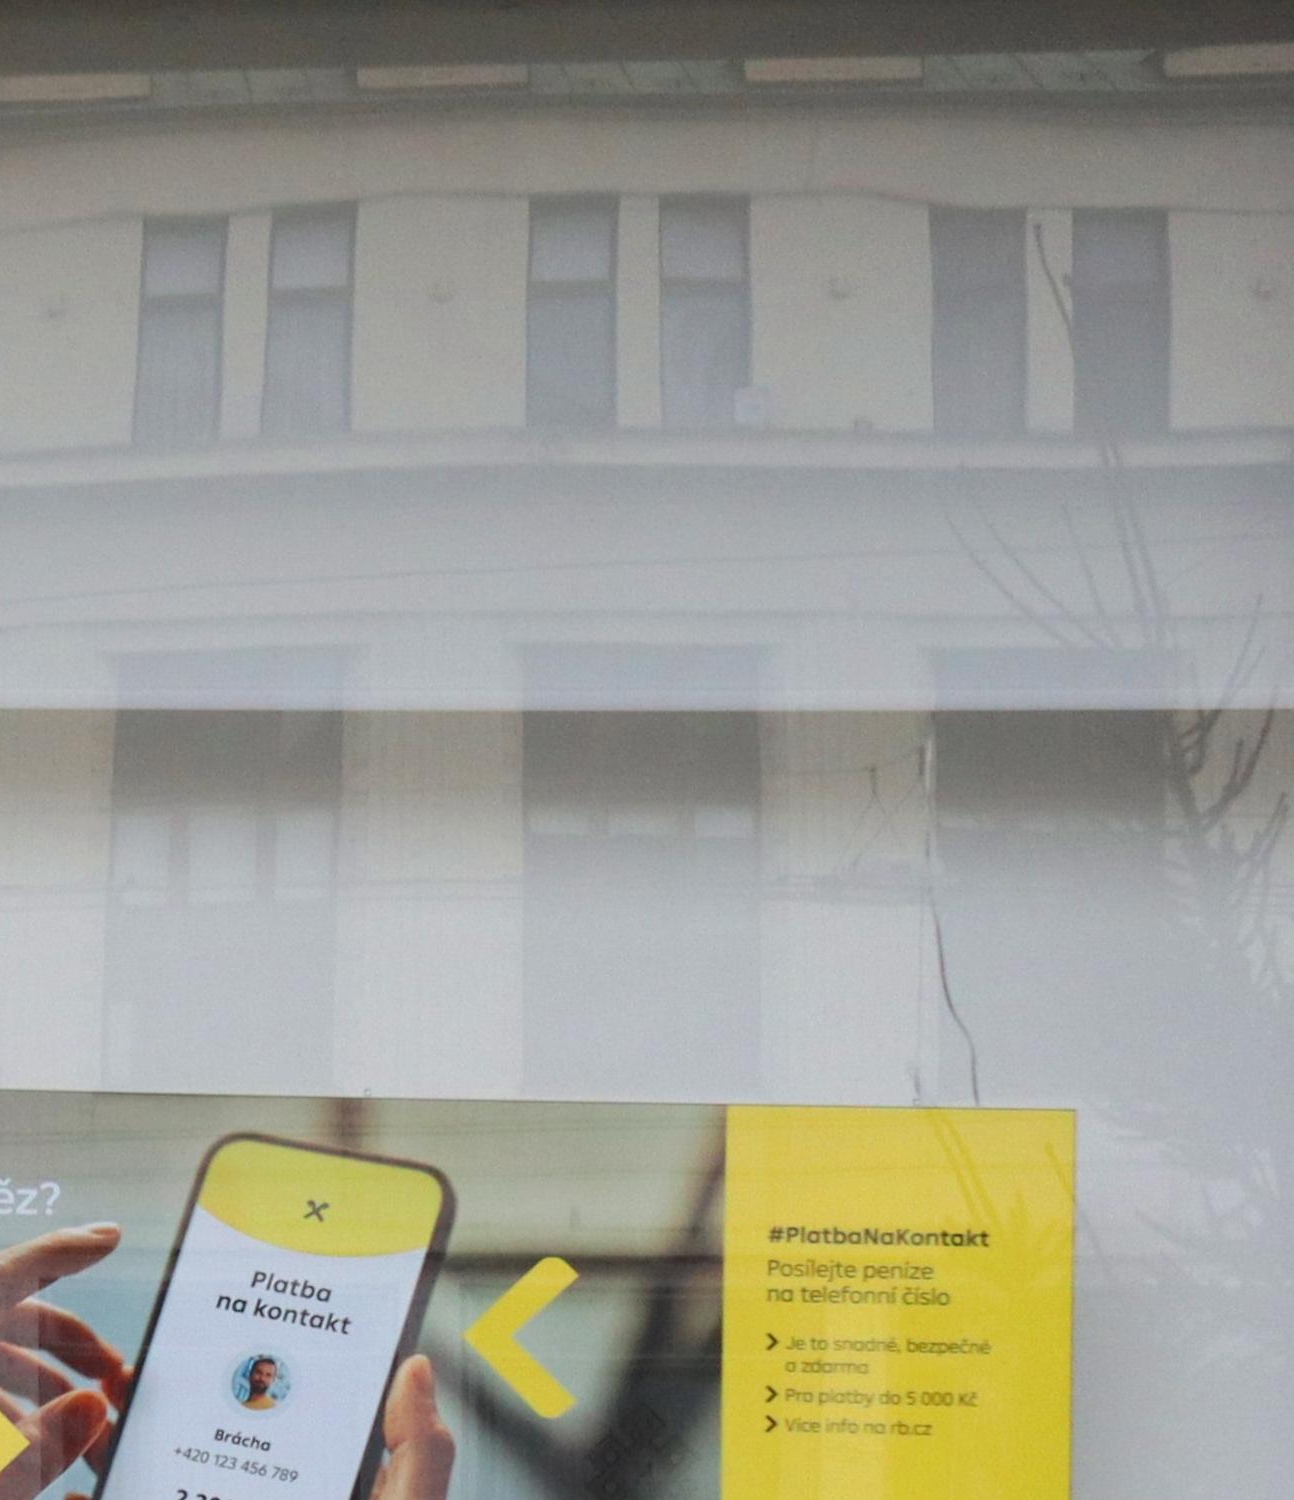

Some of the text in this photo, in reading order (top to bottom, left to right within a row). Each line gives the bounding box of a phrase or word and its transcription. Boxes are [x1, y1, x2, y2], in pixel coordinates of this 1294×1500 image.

[767, 1226, 990, 1247] #PlatbaNaKontakt
[767, 1259, 935, 1282] Posílejte peníze
[250, 1270, 332, 1303] Platba
[767, 1286, 952, 1306] na telefonní číslo
[215, 1292, 352, 1336] na kontakt
[785, 1336, 805, 1351] Je
[810, 1337, 828, 1351] to
[785, 1358, 869, 1374] a zdarma
[784, 1388, 979, 1408] Pro platby do 5 000 Kč
[785, 1417, 933, 1436] Více info na rb.cz
[214, 1428, 272, 1452] Brácha
[174, 1447, 299, 1483] +420 123 456 789
